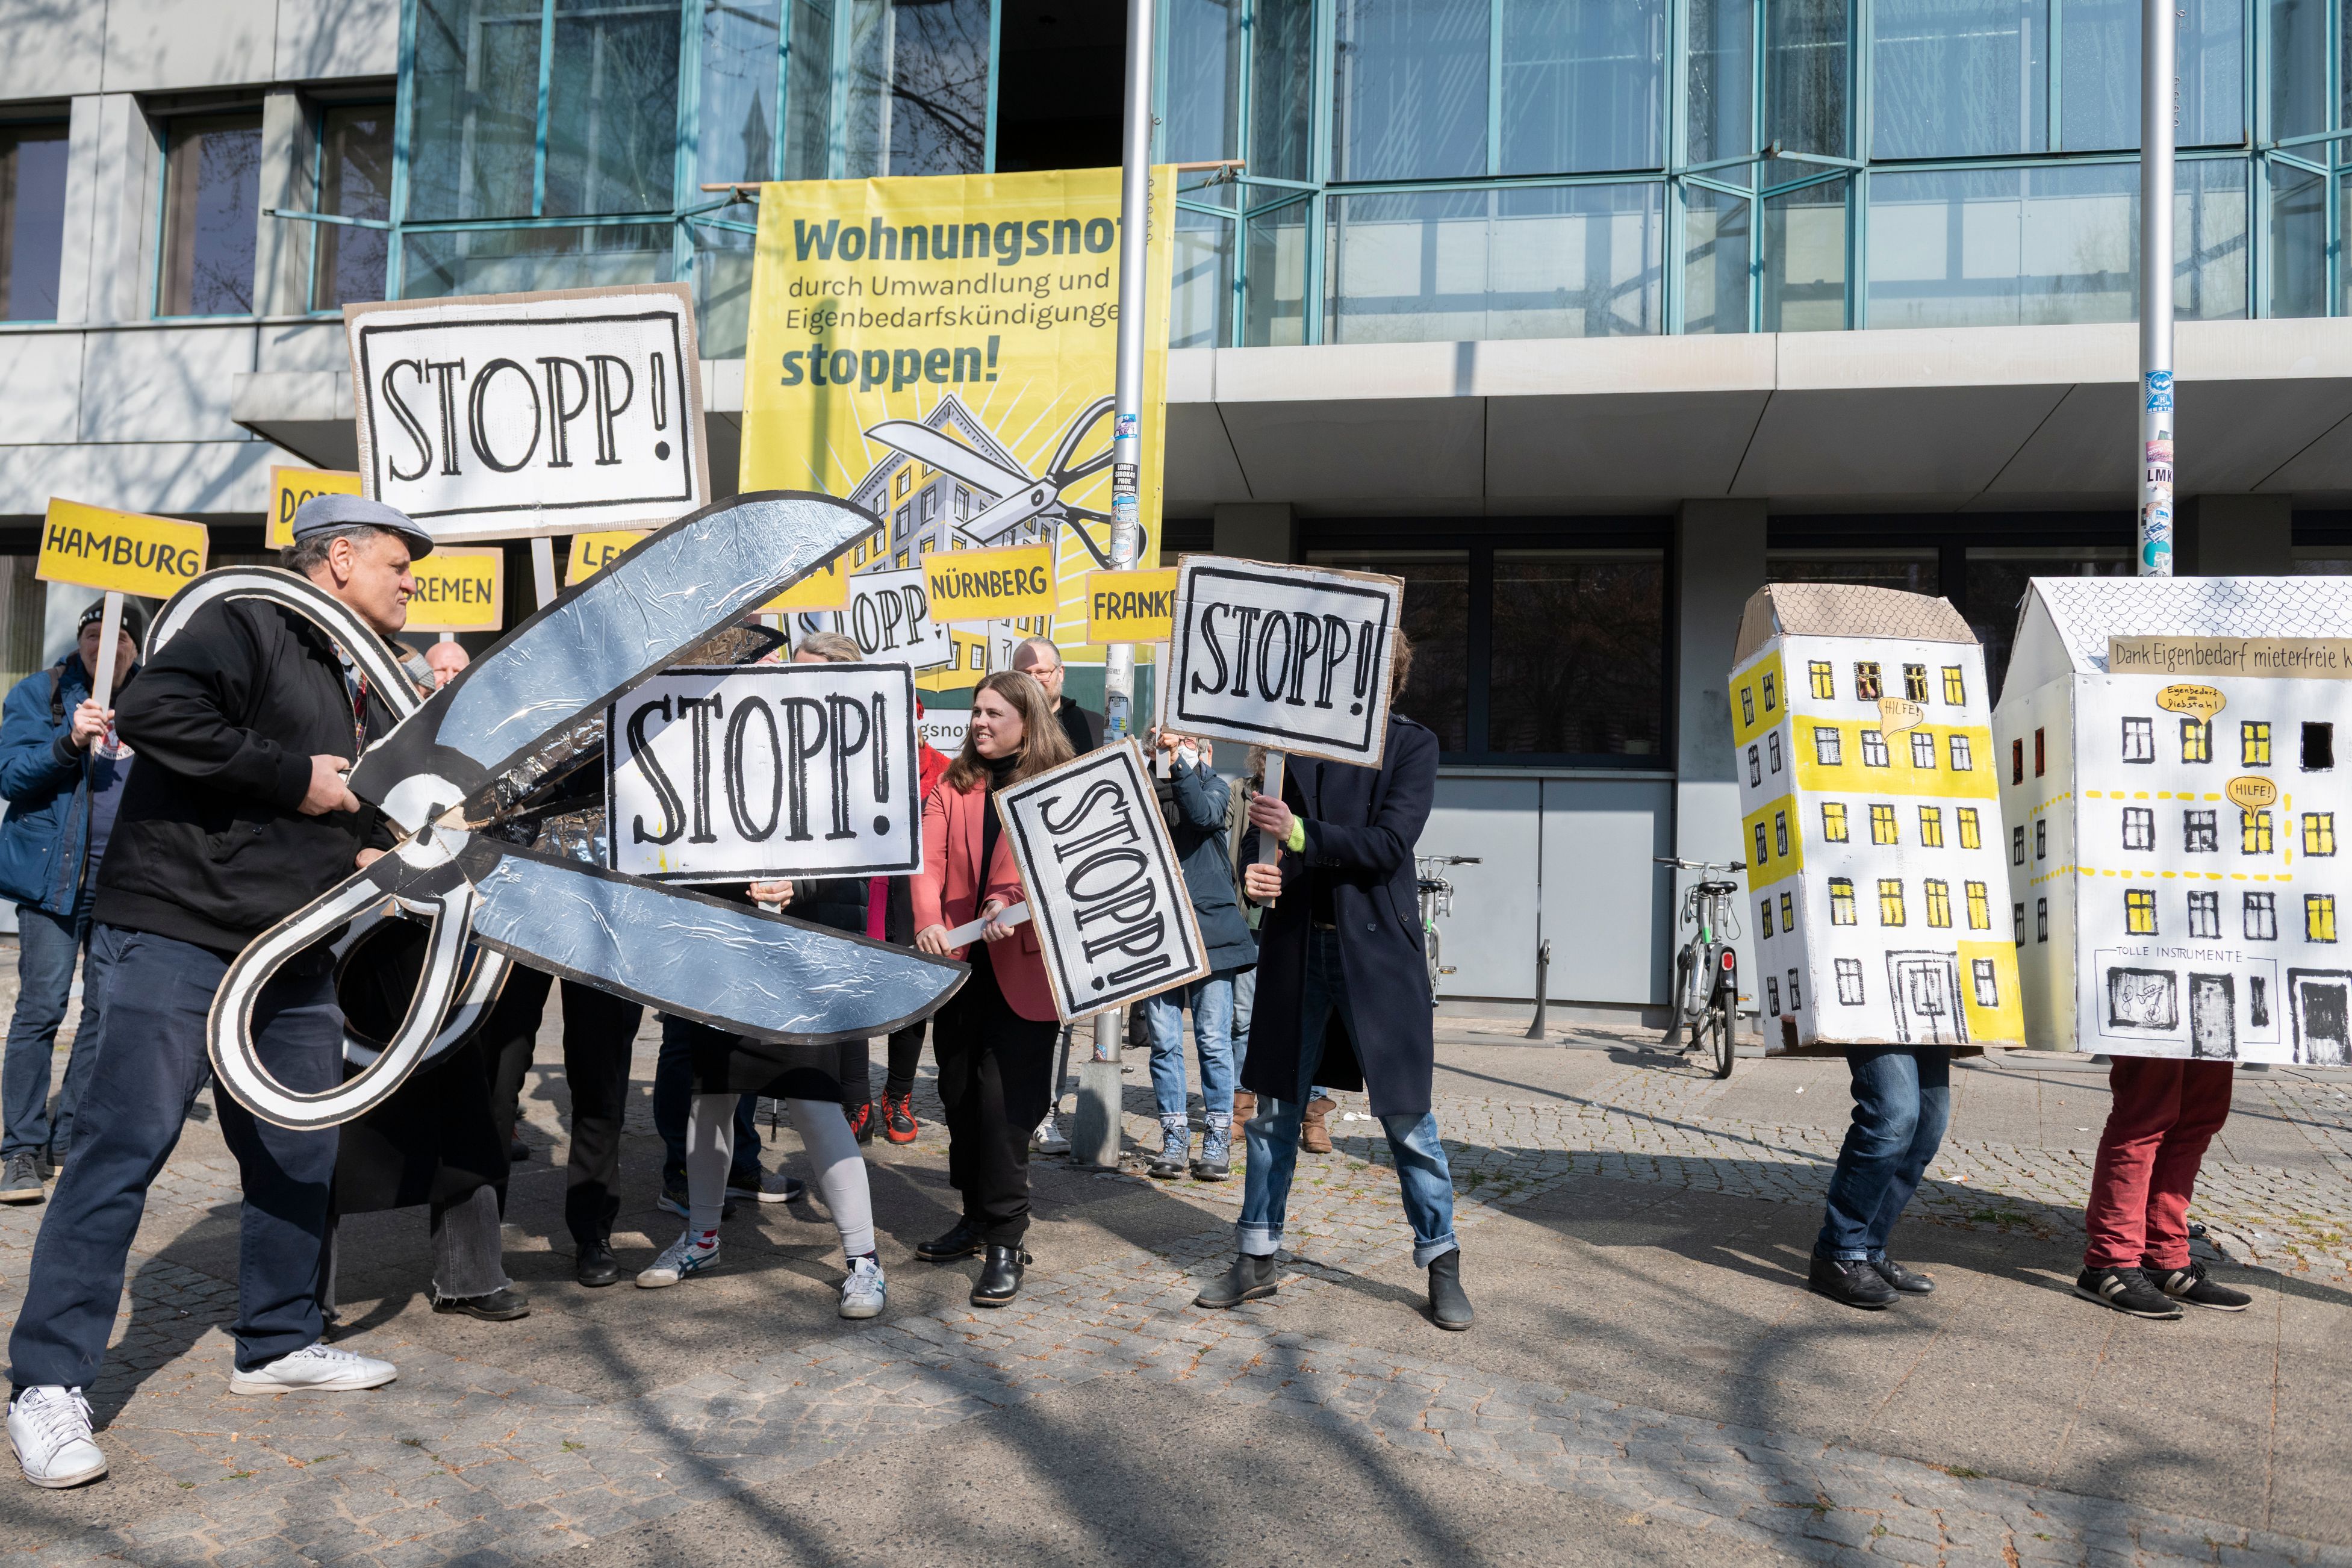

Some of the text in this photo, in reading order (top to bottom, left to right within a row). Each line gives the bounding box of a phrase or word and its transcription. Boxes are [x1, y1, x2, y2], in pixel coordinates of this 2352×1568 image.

[794, 216, 1122, 266] Wohnungsno
[789, 267, 1110, 299] durch Umwandlung und
[780, 335, 1001, 393] stoppen!
[382, 351, 671, 482] STOPP!
[47, 524, 199, 577] HAMBURG
[406, 577, 492, 604] REMEN
[931, 565, 1048, 601] NÜRNBERG
[1190, 602, 1375, 716] STOPP!
[2116, 644, 2150, 665] Dank
[2153, 642, 2248, 673] Eigenbedarf
[2254, 646, 2336, 670] mieterfreie
[1885, 700, 1920, 716] HILFE!
[2167, 686, 2218, 697] Eigenbedarf
[2167, 698, 2218, 709] Diebstahl
[626, 691, 891, 845] STOPP!
[2236, 783, 2271, 798] HILFE!
[1038, 779, 1172, 992] STOPP!
[2117, 947, 2242, 963] TOLLE INSTRUMENTE
